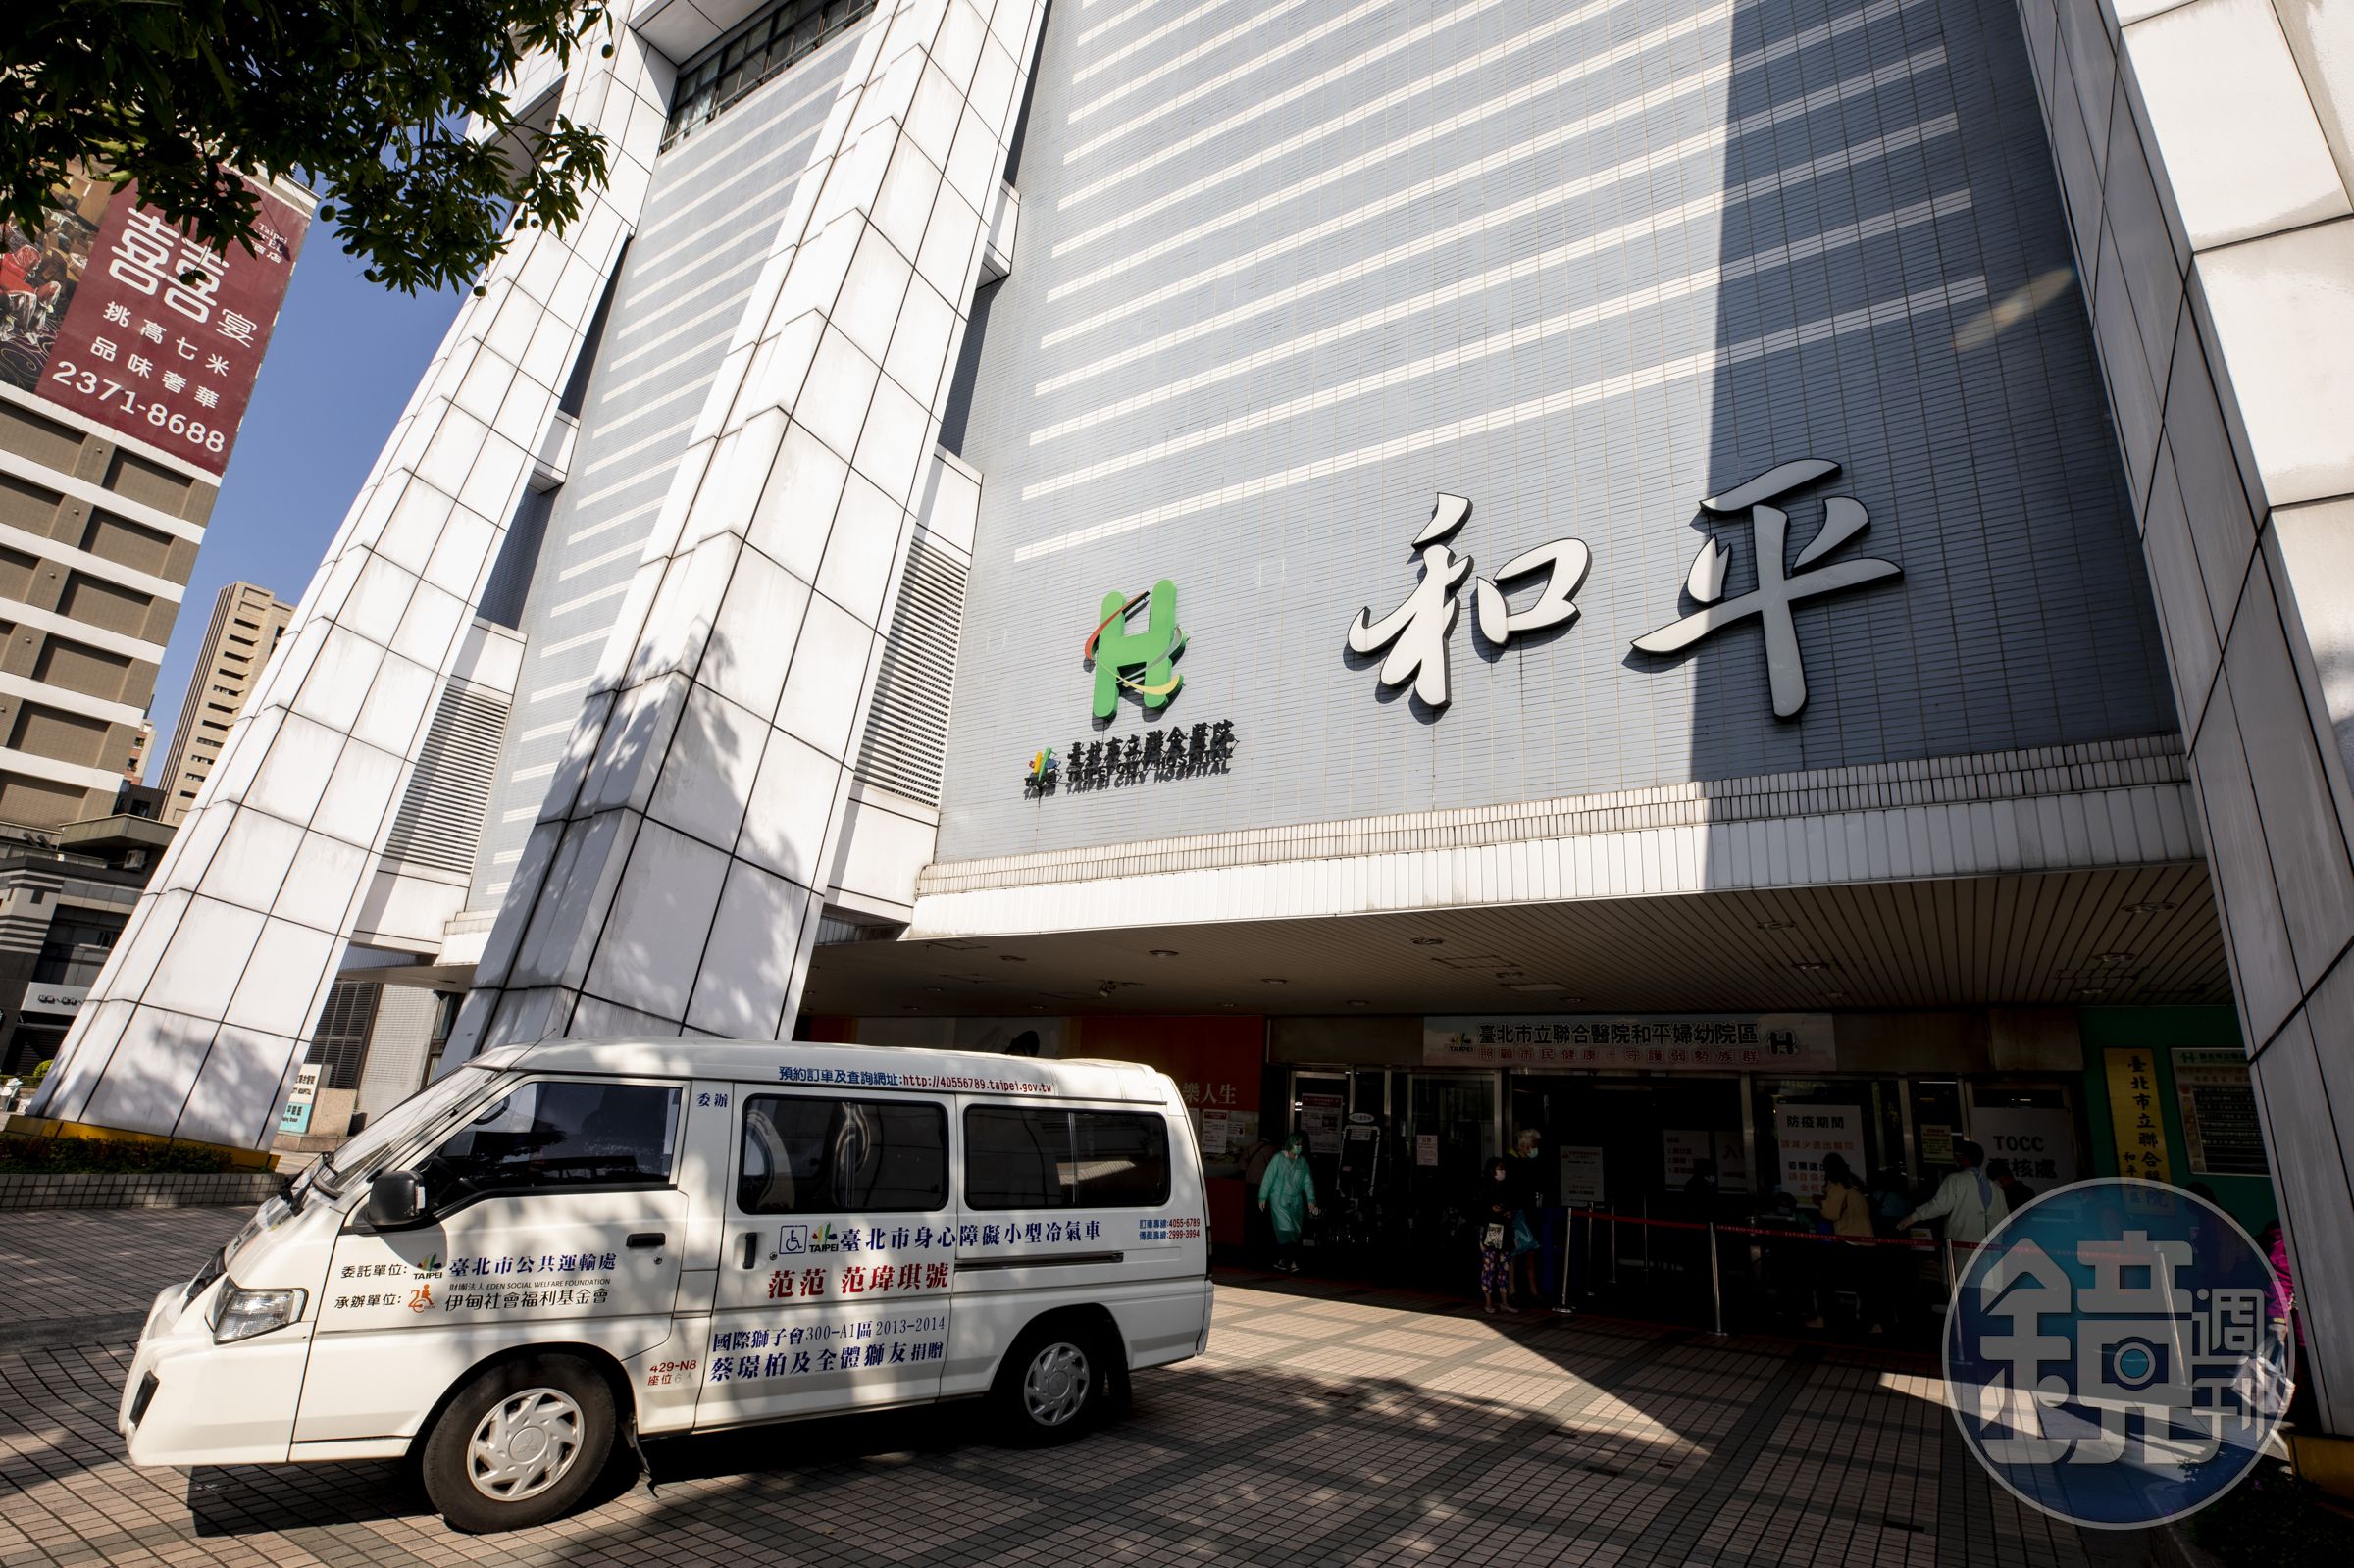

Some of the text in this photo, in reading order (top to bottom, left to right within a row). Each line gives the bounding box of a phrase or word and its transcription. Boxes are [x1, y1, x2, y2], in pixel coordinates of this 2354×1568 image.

[259, 222, 288, 245] Taipei
[103, 300, 230, 377] 挑高七米
[90, 336, 220, 410] 品味奢華
[52, 361, 226, 454] 2371-8688
[1347, 457, 1905, 722] 和平
[1479, 1023, 1759, 1045] 臺北市立聯合醫院和平婦幼院區
[697, 1092, 729, 1108] 委辦
[1786, 1115, 1845, 1129] 防疫期間
[1992, 1136, 2045, 1152] TOCC
[809, 1243, 840, 1254] TAIPEI
[840, 1220, 1100, 1253] 臺北市身心障礙小型冷氣車
[448, 1253, 617, 1277] 臺北市公共運輸處
[564, 1278, 611, 1287] FOUNDATION
[768, 1262, 949, 1299] 范范 范瑋琪號
[444, 1288, 611, 1312] 伊甸社會福利基金會
[712, 1315, 946, 1352] 國際獅子會300-A1區 2013-2014
[649, 1359, 697, 1373] 429-N8
